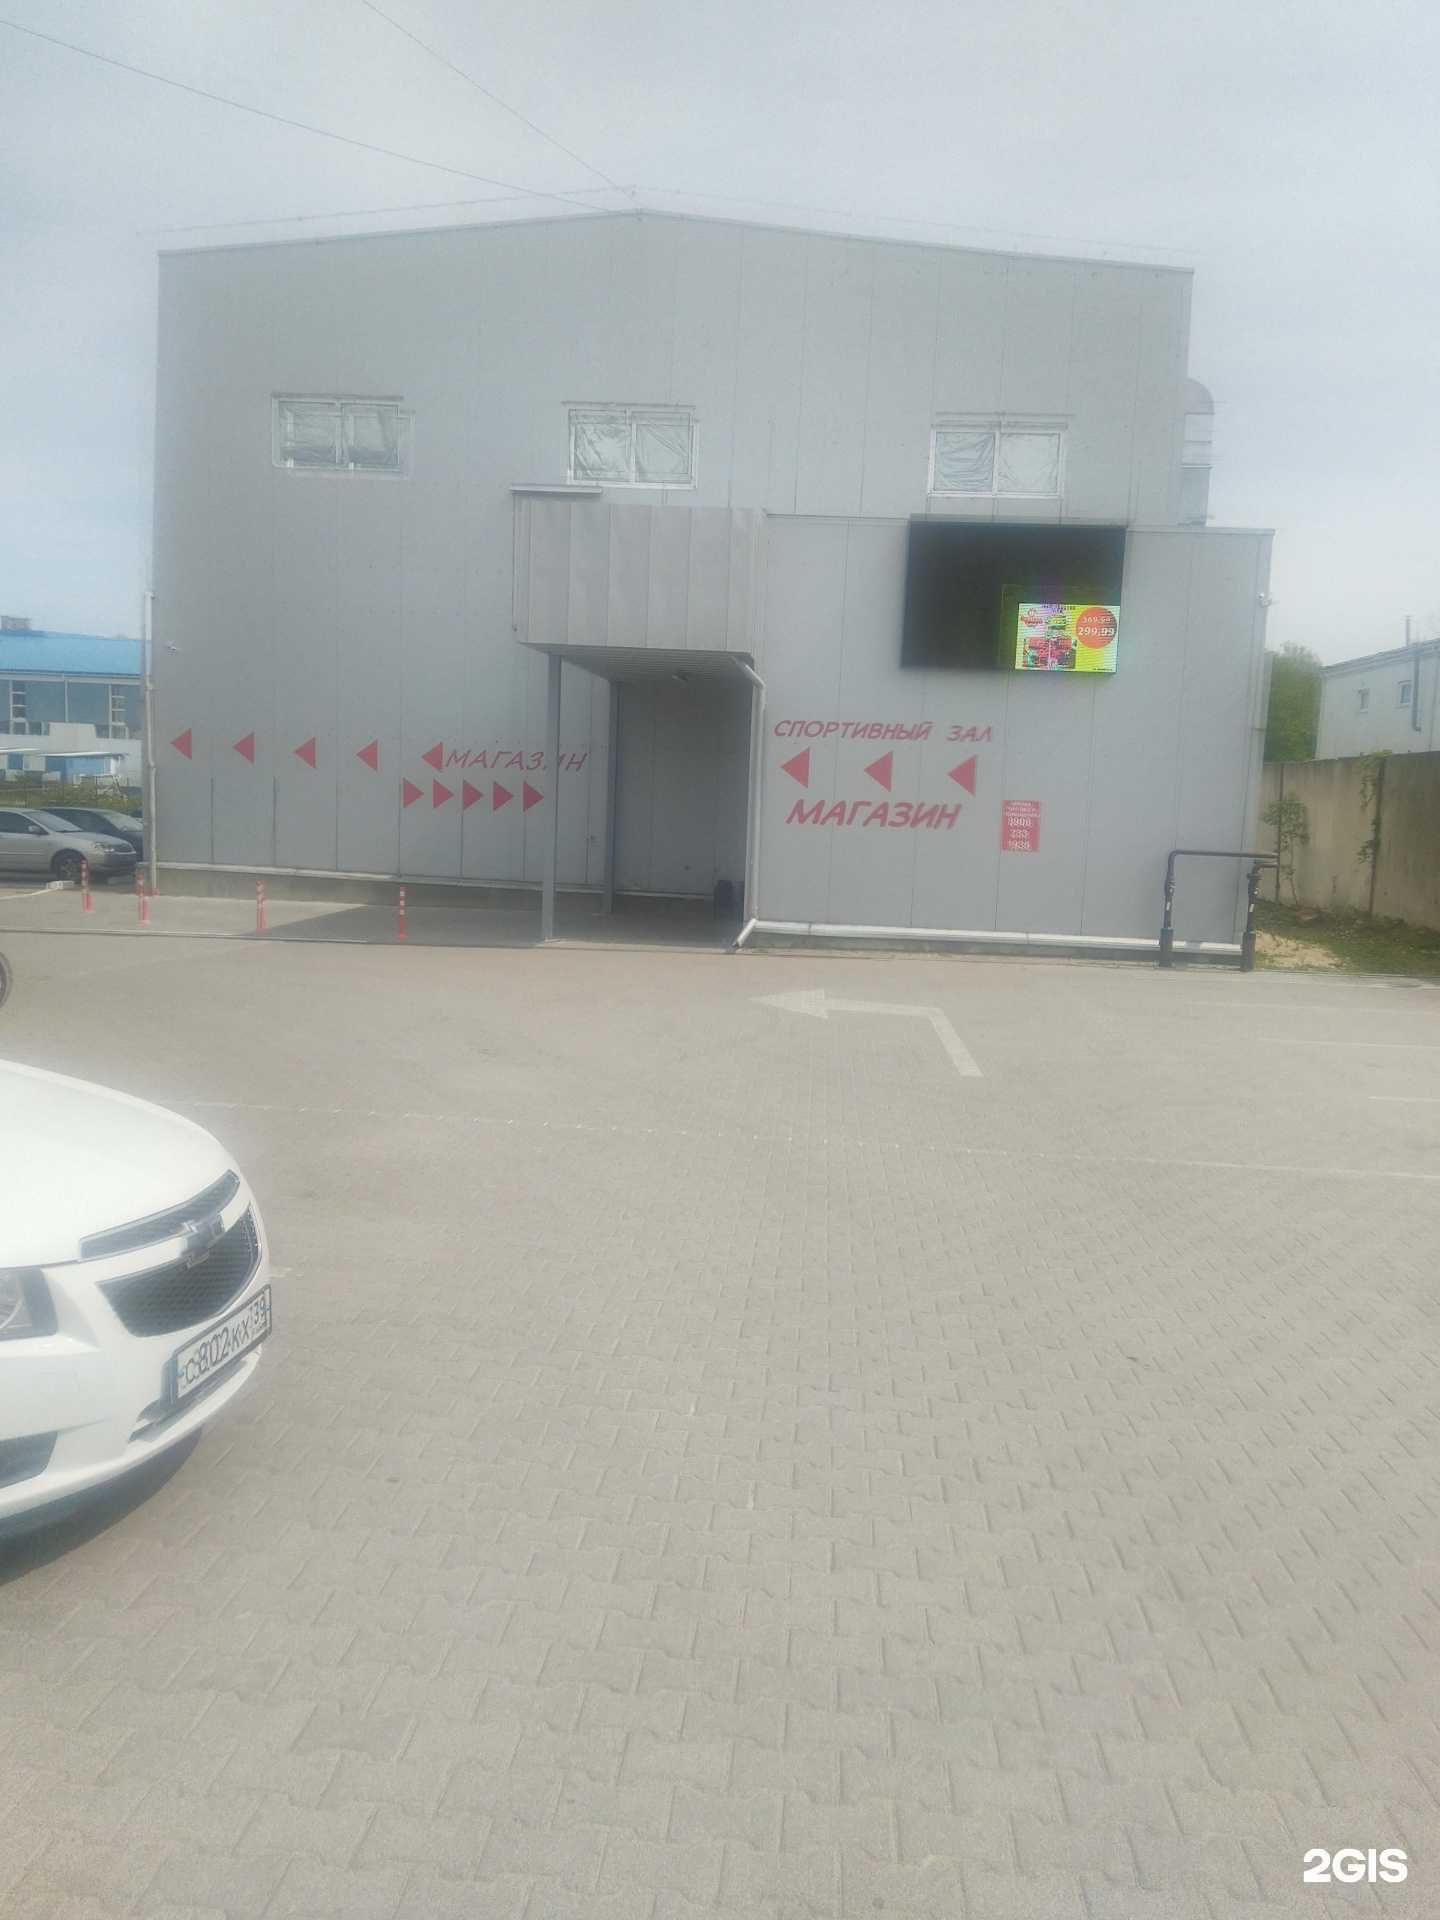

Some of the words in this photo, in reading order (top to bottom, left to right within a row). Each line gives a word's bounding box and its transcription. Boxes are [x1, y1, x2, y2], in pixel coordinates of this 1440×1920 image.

[773, 720, 935, 740] СПОРТИВНЫЙ
[946, 725, 993, 743] ЗАЛ
[785, 799, 962, 829] МАГАЗИН
